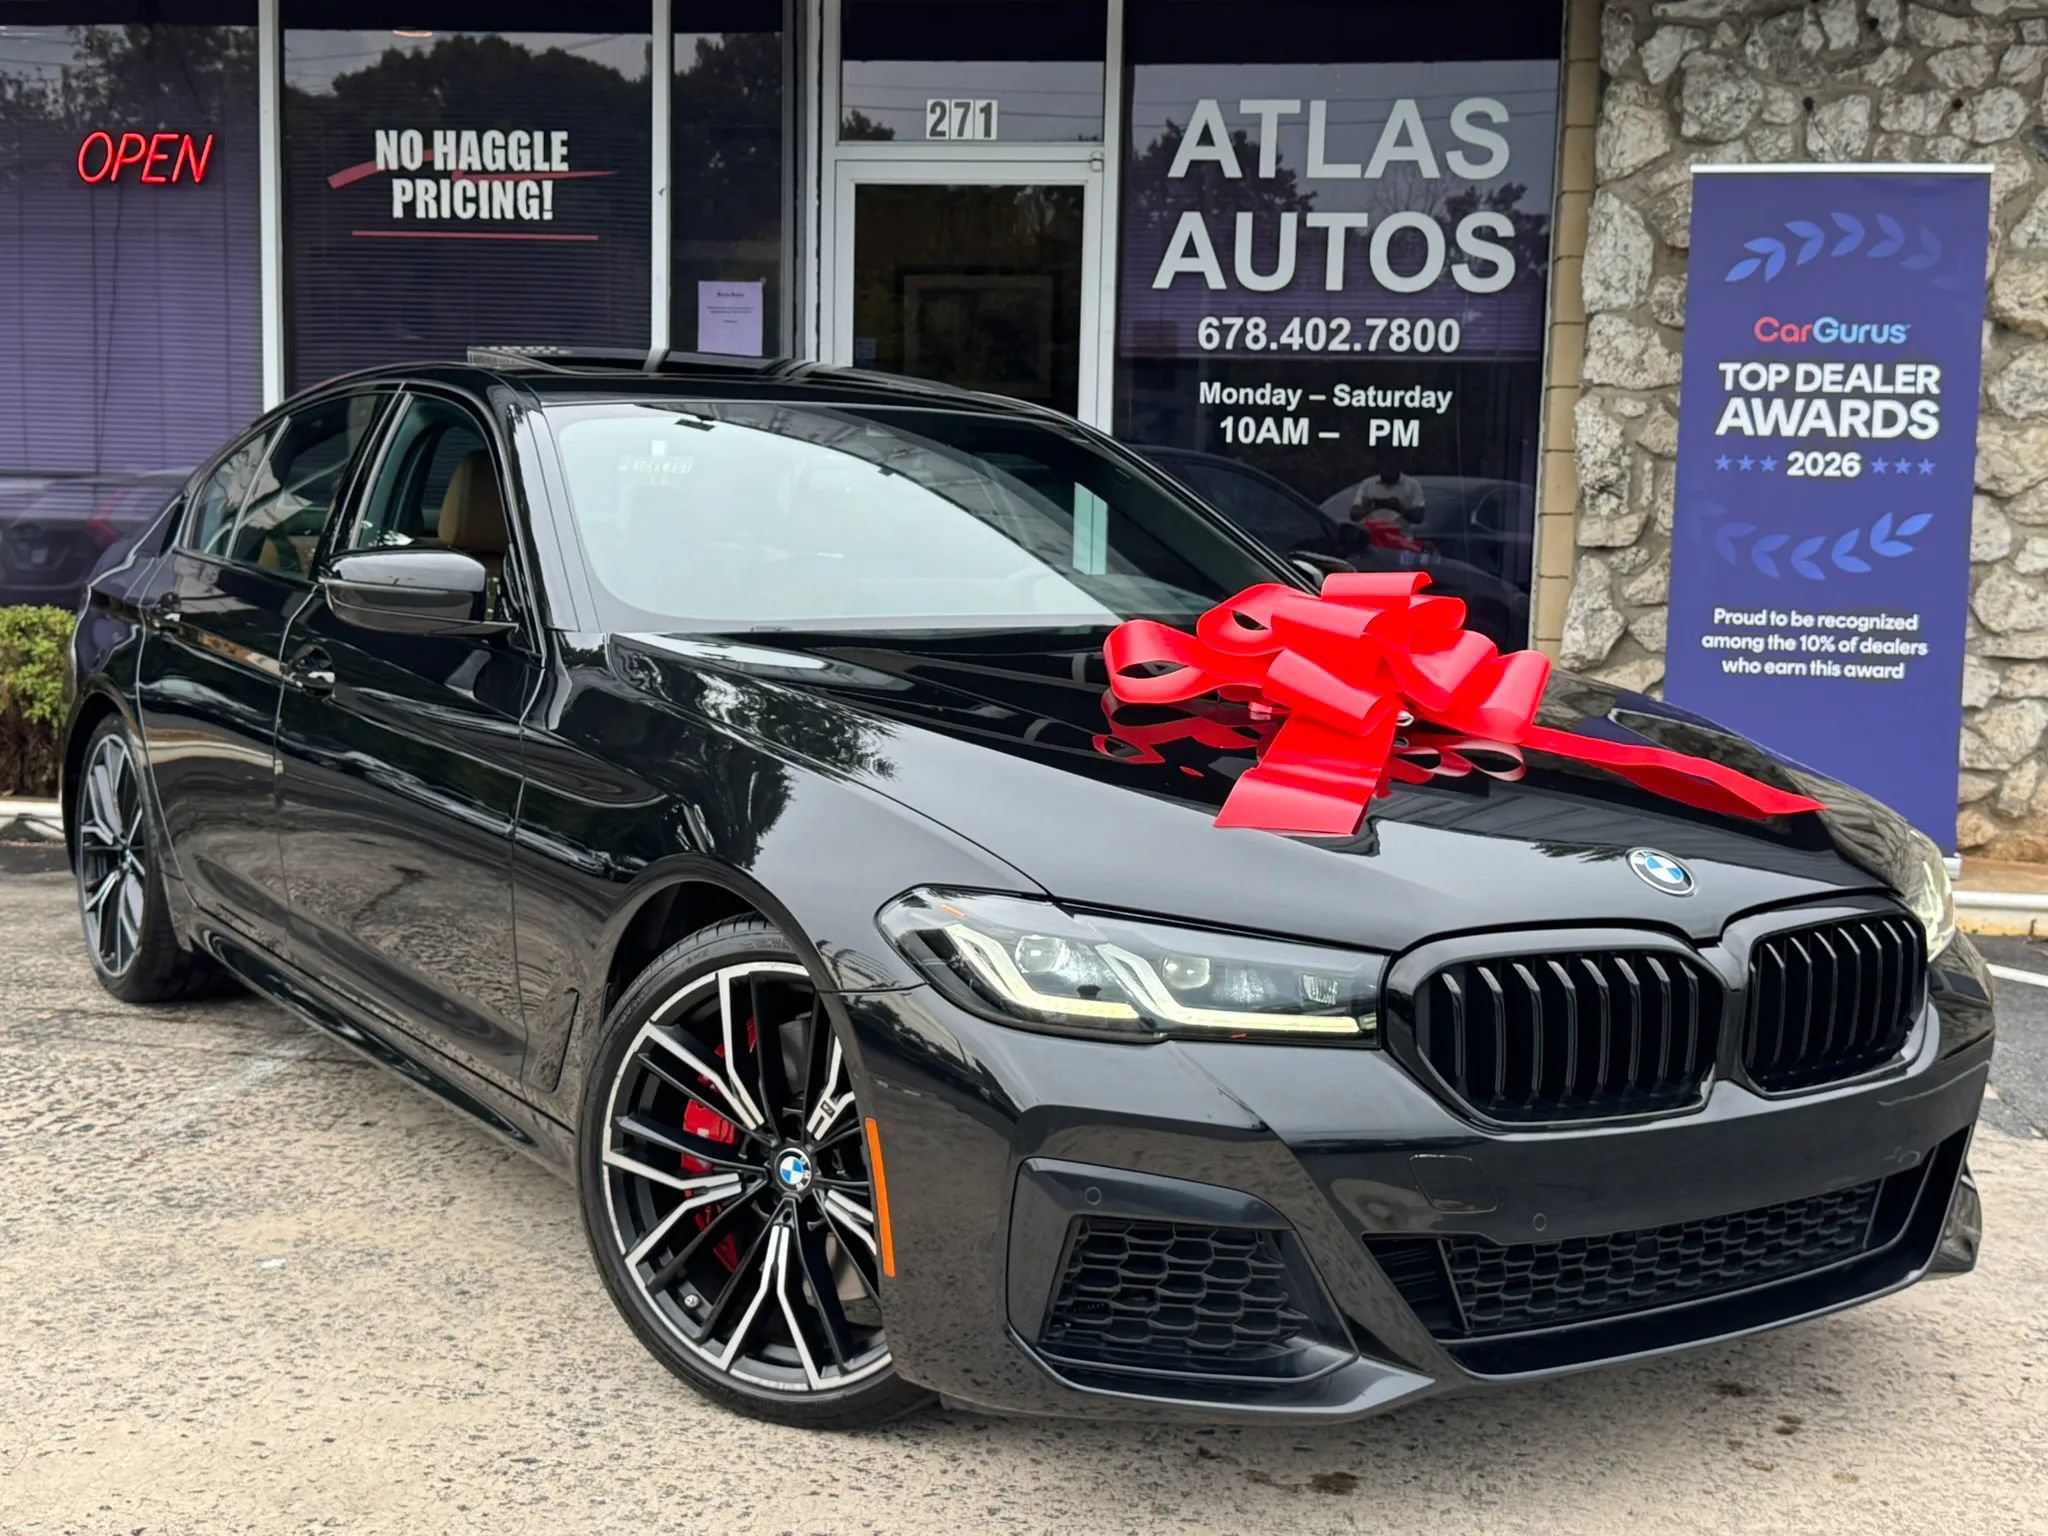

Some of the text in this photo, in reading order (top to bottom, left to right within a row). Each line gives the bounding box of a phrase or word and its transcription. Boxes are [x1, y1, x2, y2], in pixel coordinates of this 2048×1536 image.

[929, 101, 993, 138] 271
[375, 129, 569, 173] NO HAGGLE
[1167, 98, 1511, 180] ATLAS
[77, 131, 214, 184] OPEN
[392, 178, 554, 221] PRICING!
[1152, 211, 1516, 293] AUTOS
[1197, 316, 1461, 353] 678.402.7800
[1754, 316, 1908, 345] CarGurus
[1718, 362, 1941, 395] TOP DEALER
[1199, 381, 1303, 412] Monday
[1332, 383, 1454, 414] Saturday
[1220, 415, 1310, 446] 10AM
[1368, 418, 1420, 447] PM
[1714, 396, 1940, 440] AWARDS
[1786, 451, 1862, 478] 2026
[1713, 607, 1919, 632] Proud to be recognized
[1701, 633, 1928, 656] among the 10% of dealers
[1721, 656, 1905, 679] who earn this award
